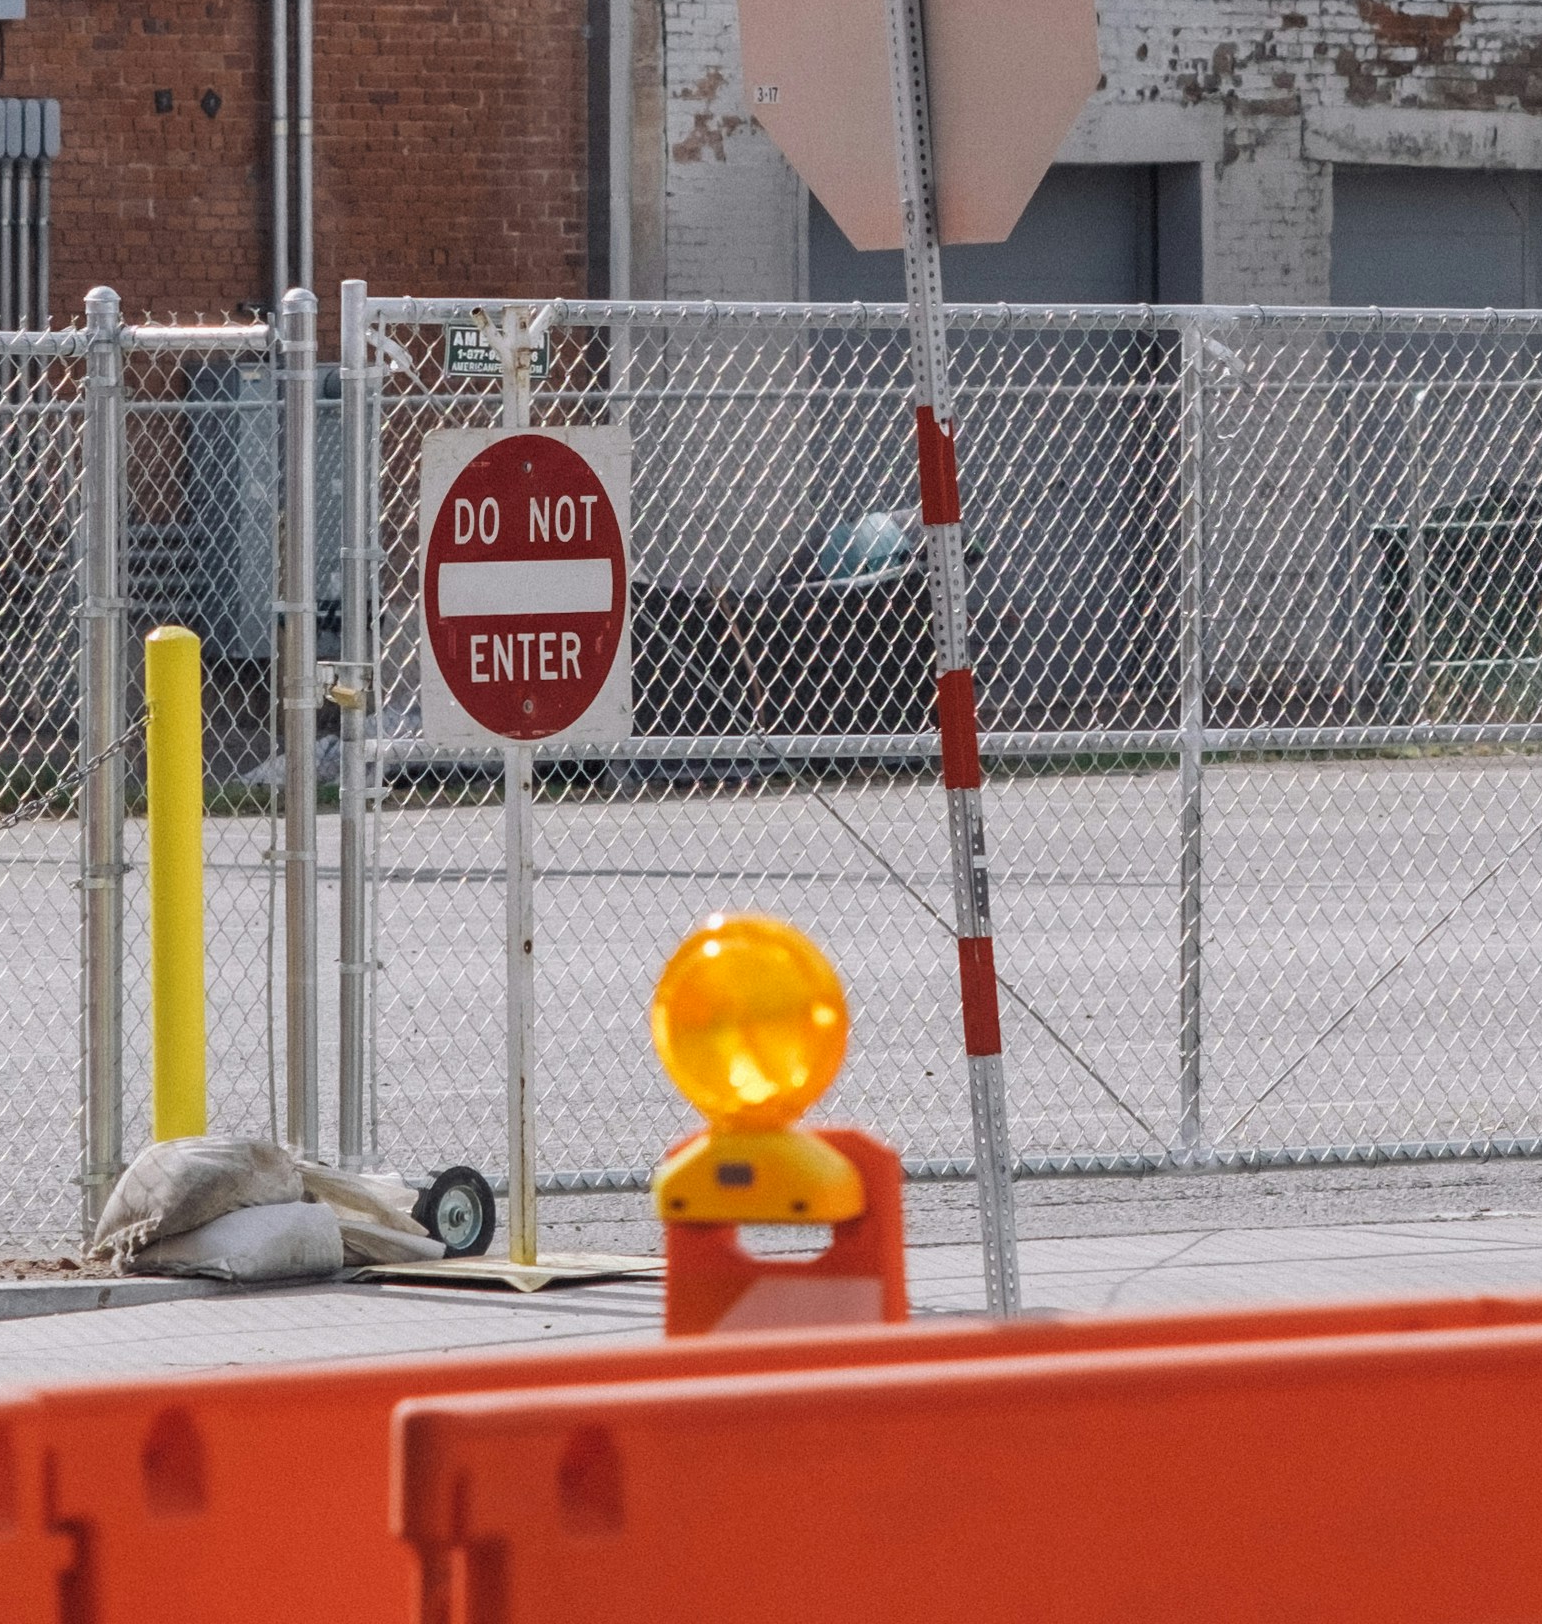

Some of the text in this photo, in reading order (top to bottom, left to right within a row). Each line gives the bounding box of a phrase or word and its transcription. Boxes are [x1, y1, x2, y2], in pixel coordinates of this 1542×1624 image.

[453, 495, 598, 545] DO NOT
[470, 632, 582, 683] ENTER
